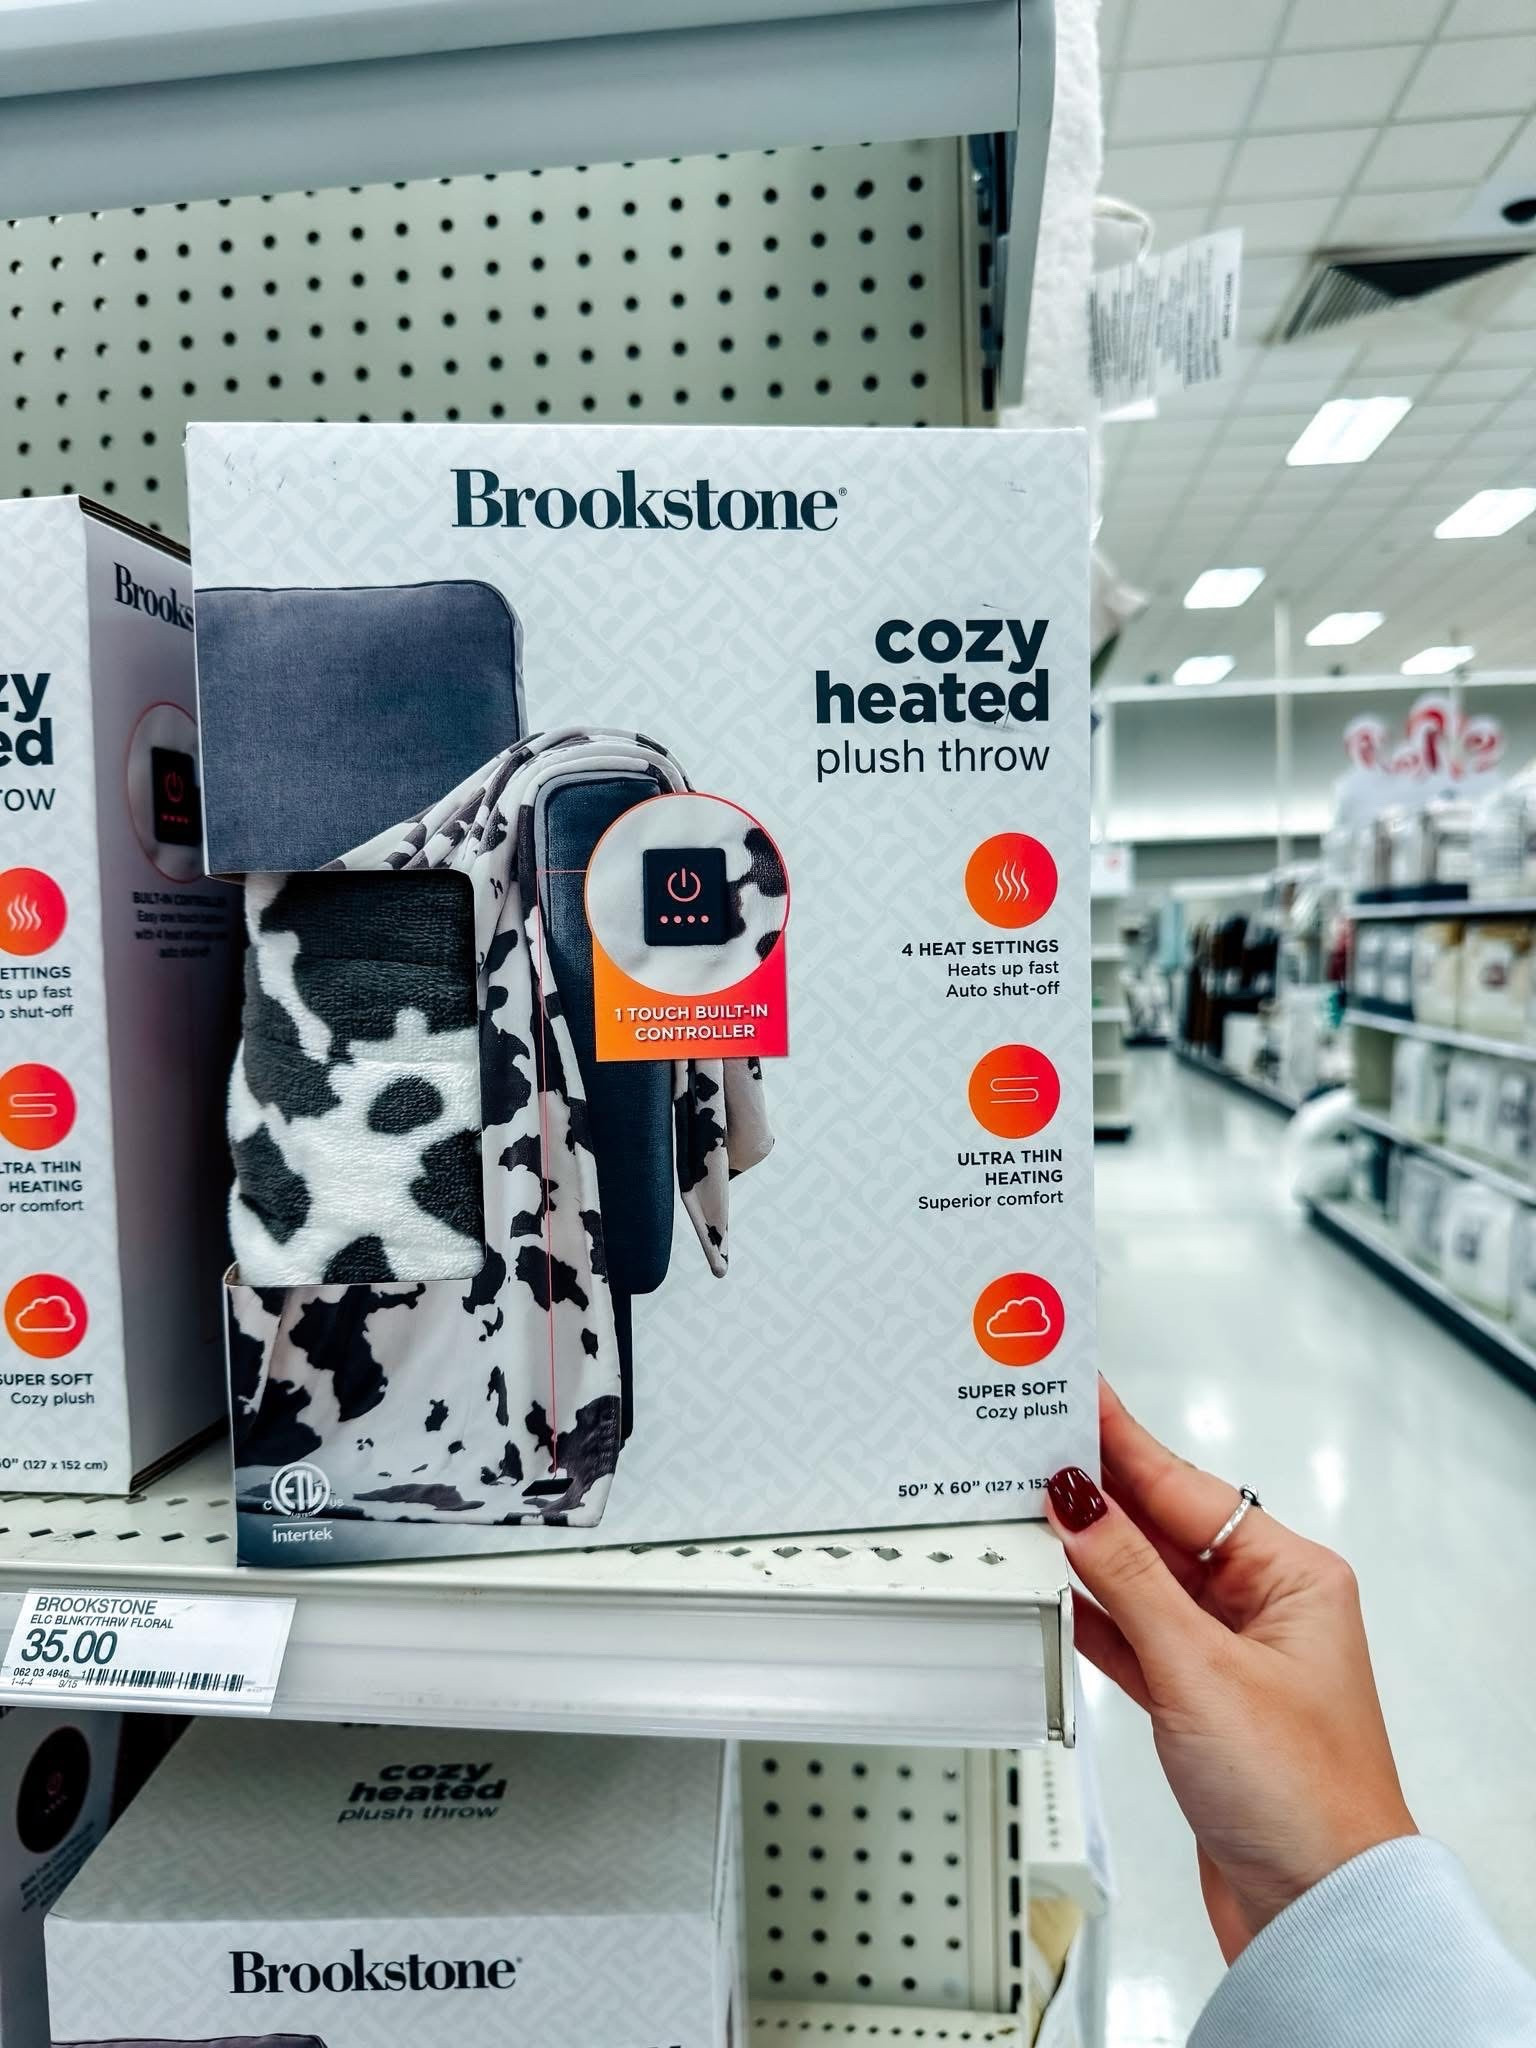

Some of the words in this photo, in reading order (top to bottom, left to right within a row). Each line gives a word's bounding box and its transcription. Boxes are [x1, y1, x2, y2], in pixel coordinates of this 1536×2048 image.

[875, 619, 1049, 674] cozy
[0, 673, 51, 723] y
[816, 669, 1050, 724] heated
[817, 741, 924, 782] plush
[939, 739, 1050, 773] throw
[0, 788, 56, 812] ow
[902, 943, 913, 957] 4
[919, 942, 966, 956] HEAT
[972, 940, 1059, 955] SETTINGS
[947, 962, 996, 977] Heats
[1002, 964, 1023, 979] up
[1029, 960, 1059, 975] fast
[17, 988, 38, 1002] up
[43, 985, 73, 998] fast
[946, 984, 987, 998] Auto
[993, 980, 1060, 997] shut-off
[10, 1004, 74, 1018] shut-off
[615, 1009, 622, 1021] 1
[627, 1006, 690, 1021] TOUCH
[695, 1004, 769, 1019] BUILT-IN
[635, 1025, 756, 1041] CONTROLLER
[957, 1151, 1016, 1166] ULTRA
[1021, 1149, 1063, 1164] THIN
[0, 1161, 37, 1174] TRA
[41, 1160, 82, 1173] THIN
[9, 1179, 83, 1193] HEATING
[985, 1169, 1064, 1186] HEATING
[20, 1199, 84, 1212] comfort
[918, 1194, 991, 1212] Superior
[997, 1190, 1064, 1207] comfort
[50, 1373, 94, 1385] SOFT
[957, 1382, 1016, 1399] SUPER
[1022, 1380, 1068, 1395] SOFT
[10, 1391, 48, 1407] Cozy
[53, 1391, 95, 1407] plush
[976, 1404, 1018, 1420] Cozy
[1023, 1400, 1068, 1419] plush
[23, 1459, 47, 1471] (127
[50, 1462, 57, 1470] x
[61, 1459, 81, 1470] 152
[84, 1460, 108, 1471] cm)
[934, 1483, 945, 1495] X
[985, 1480, 1013, 1494] (127
[1017, 1482, 1024, 1490] x
[1029, 1478, 1050, 1490] 152
[272, 1527, 333, 1543] Intertek
[35, 1596, 158, 1615] BROOKSTONE
[30, 1614, 52, 1625] ELC
[54, 1616, 129, 1627] BLNKT/THRW
[130, 1617, 174, 1629] FLORAL
[21, 1628, 118, 1664] 35.00
[13, 1667, 31, 1677] 062
[32, 1668, 45, 1677] 03
[46, 1669, 70, 1678] 4946
[379, 1762, 493, 1783] cozy
[348, 1779, 508, 1803] heated
[337, 1805, 413, 1824] plush
[422, 1805, 500, 1820] throw
